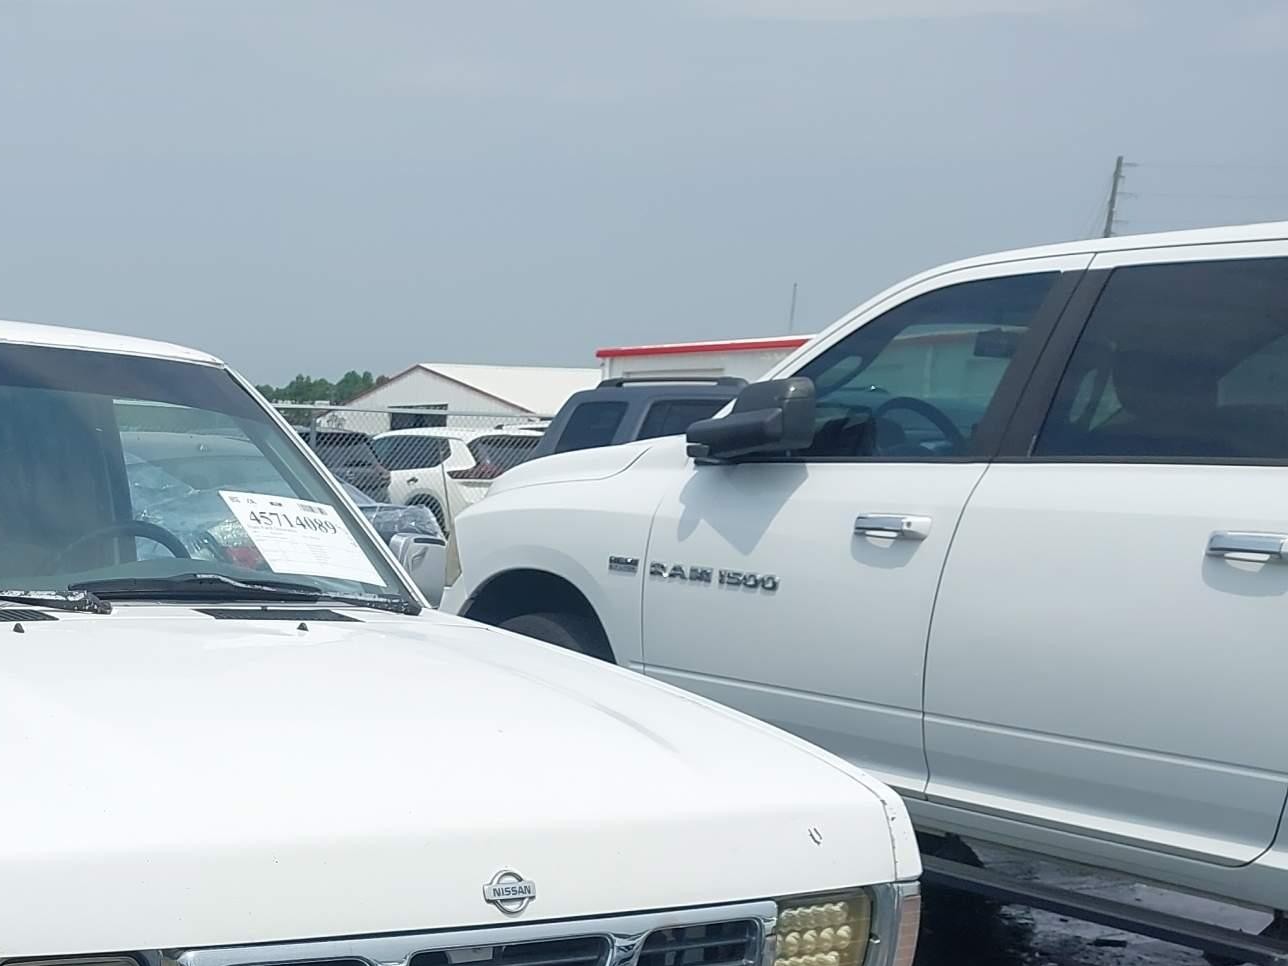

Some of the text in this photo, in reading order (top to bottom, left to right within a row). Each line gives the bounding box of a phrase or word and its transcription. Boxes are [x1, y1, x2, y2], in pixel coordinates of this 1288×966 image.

[248, 510, 337, 535] 45714089
[649, 561, 713, 583] RAM
[718, 568, 779, 591] 1500
[492, 885, 531, 897] NISSAN
